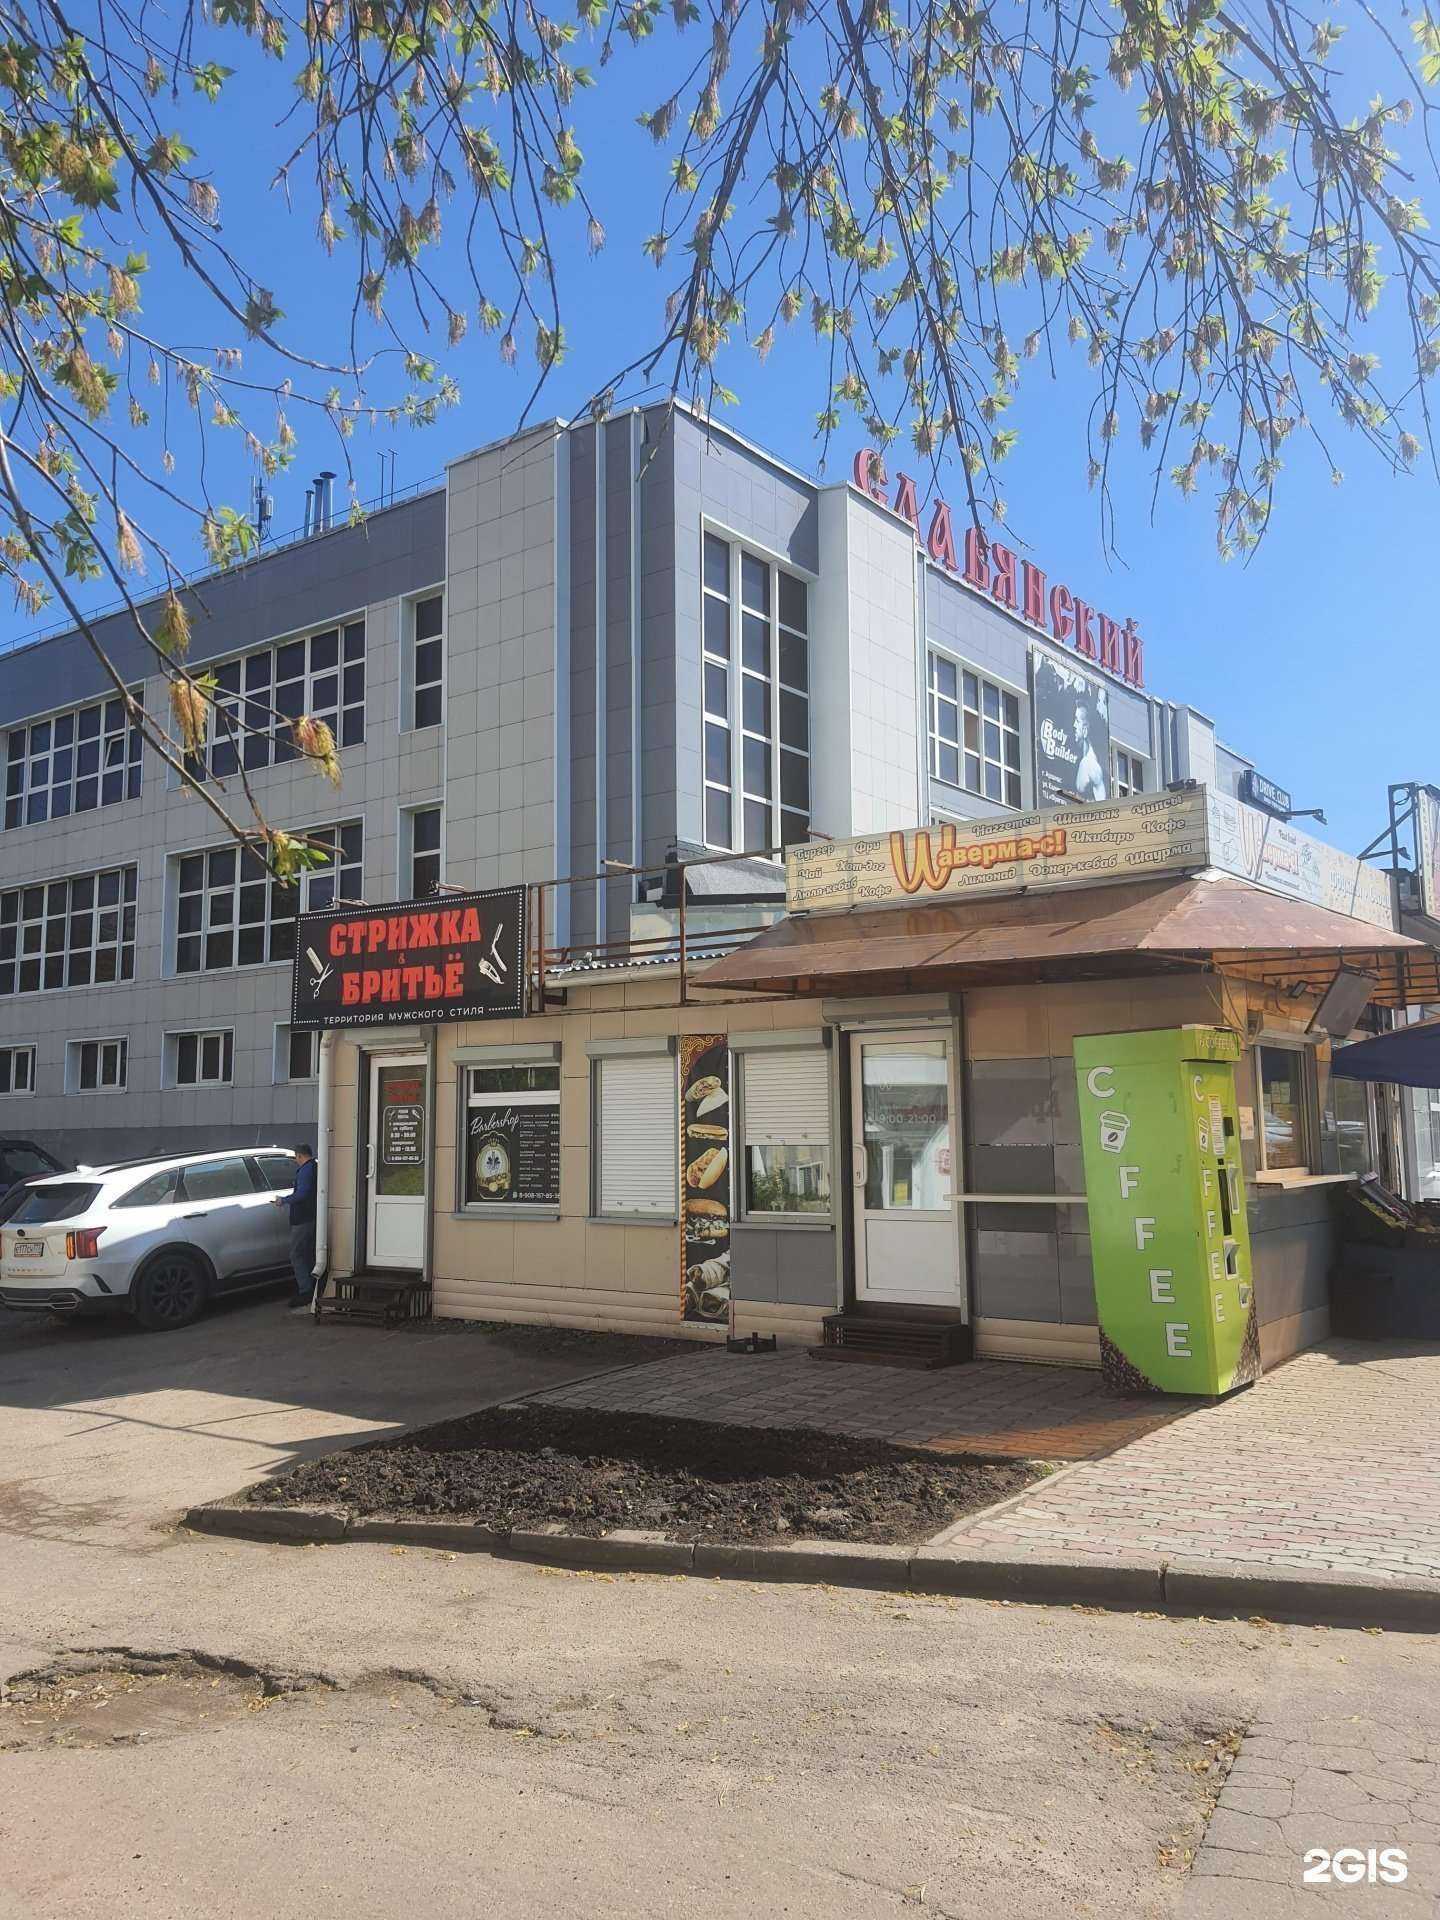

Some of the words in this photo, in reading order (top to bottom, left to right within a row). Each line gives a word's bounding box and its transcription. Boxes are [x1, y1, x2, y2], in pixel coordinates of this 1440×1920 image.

[853, 447, 1145, 689] СЛАВЯНСКИЙ
[1042, 718, 1068, 746] Body
[1045, 736, 1078, 764] Builder
[1132, 794, 1183, 816] Чипсы
[972, 815, 1041, 837] Наггетсы
[1053, 808, 1120, 825] Шашлык
[1142, 818, 1186, 835] Кофе
[793, 844, 835, 862] Бургер
[854, 840, 881, 854] Фри
[1125, 842, 1192, 866] Шаурма
[798, 867, 823, 880] Чай
[836, 860, 886, 872] Хот-дог
[1029, 853, 1118, 877] Донер-кебаб
[958, 867, 1017, 887] Лимонад
[858, 884, 893, 899] Кофе
[329, 907, 482, 958] СТРИЖКА
[341, 952, 465, 1006] БРИТЬЁ
[323, 1012, 385, 1025] ТЕРРИТОРИЯ
[388, 1008, 445, 1021] МУЖСКОГО
[449, 1005, 485, 1018] СТИЛЯ
[470, 1108, 520, 1136] Barbershop
